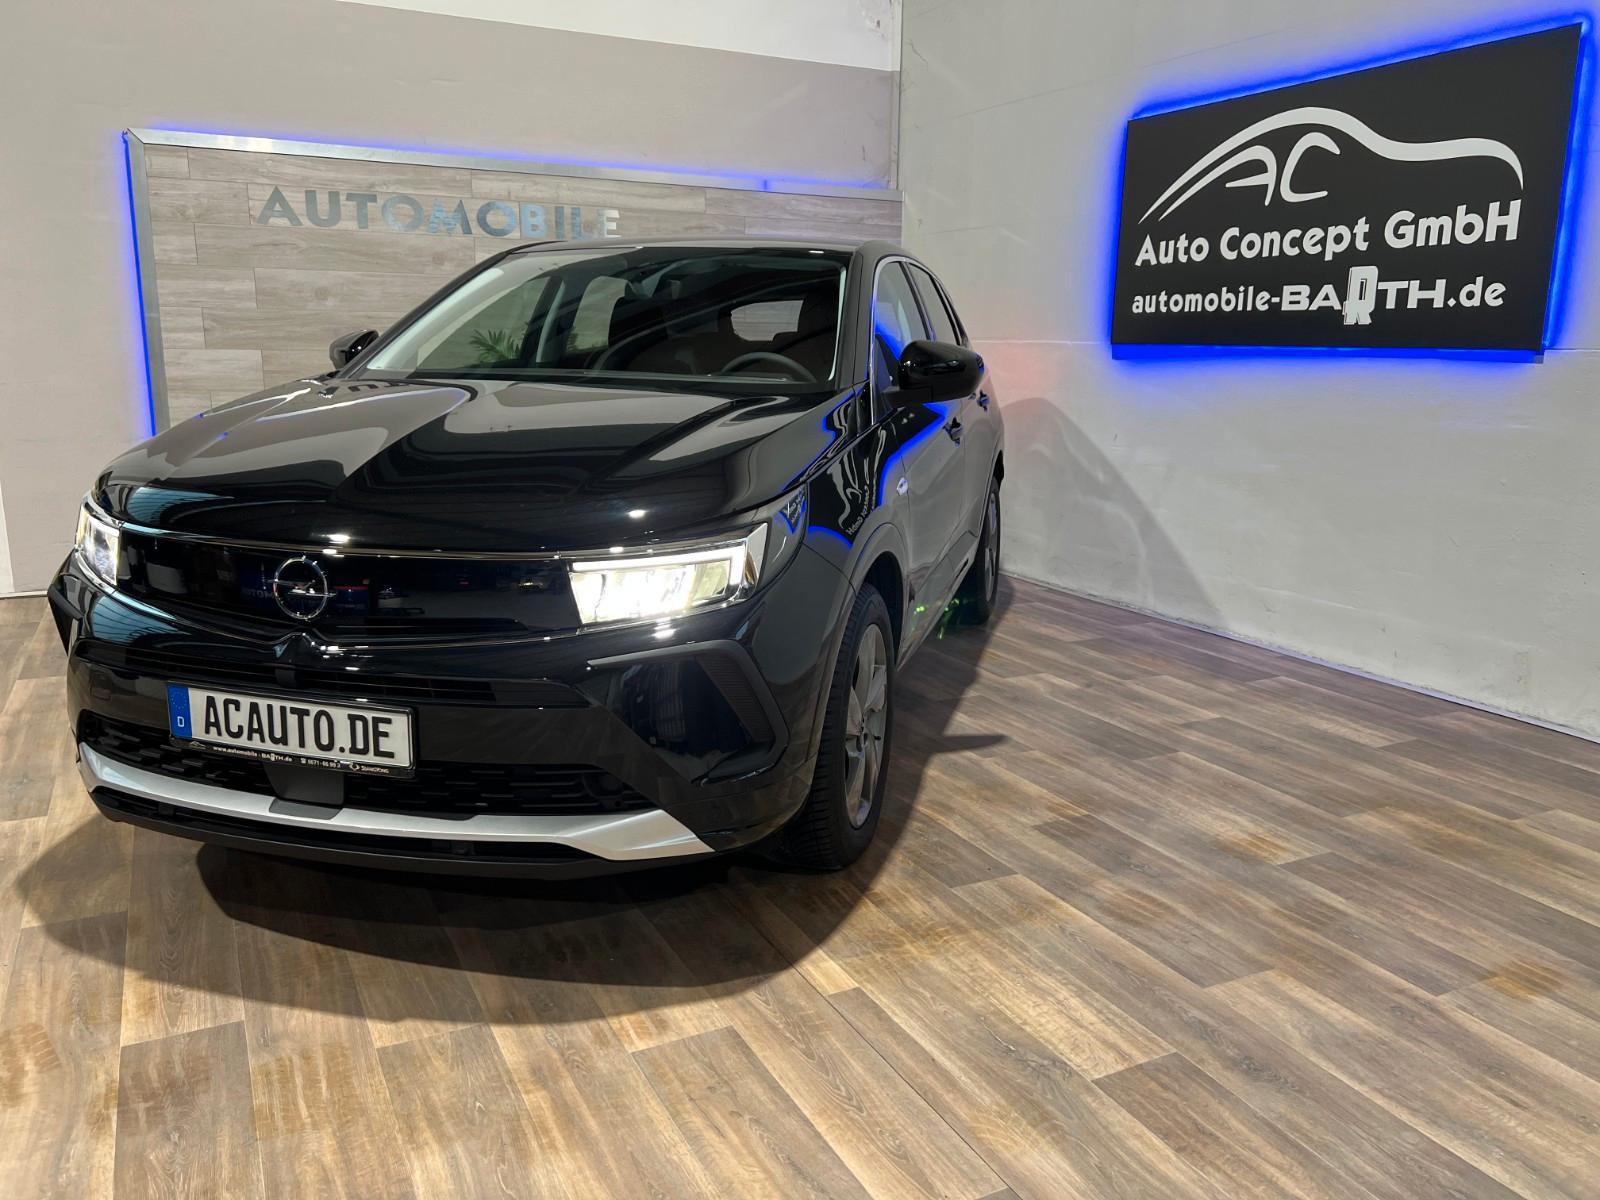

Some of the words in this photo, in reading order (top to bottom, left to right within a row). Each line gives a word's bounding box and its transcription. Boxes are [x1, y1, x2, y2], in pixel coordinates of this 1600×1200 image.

[256, 185, 622, 240] AUTOMOBILE
[1135, 234, 1210, 267] Auto
[1219, 216, 1370, 261] Concept
[1384, 199, 1522, 249] GmbH
[177, 715, 185, 728] D
[203, 695, 395, 759] ACAUTO.DE
